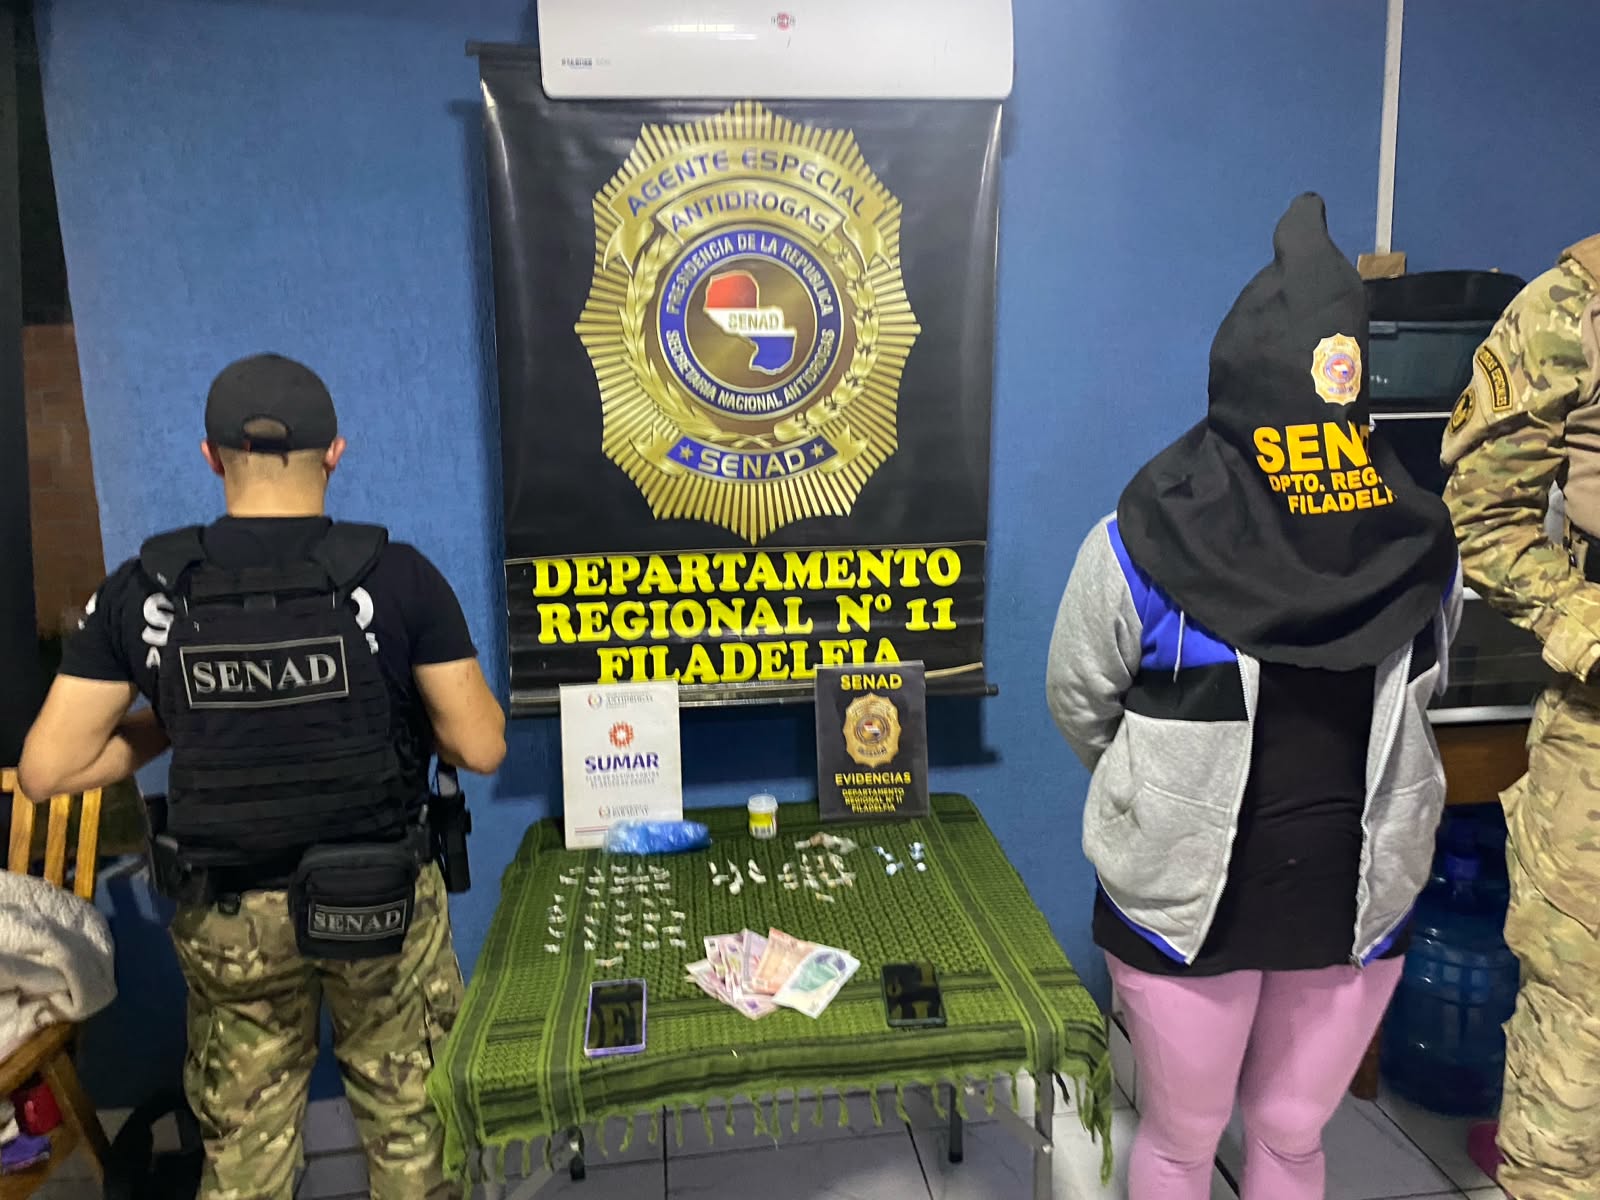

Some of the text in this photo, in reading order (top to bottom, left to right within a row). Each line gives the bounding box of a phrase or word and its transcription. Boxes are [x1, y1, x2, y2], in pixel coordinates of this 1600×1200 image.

[627, 147, 865, 216] AGENTE ESPECIAL
[671, 190, 830, 233] ANTIDROGAS
[666, 237, 734, 316] PRESIDENCIA
[737, 233, 756, 251] DE
[760, 235, 777, 254] LA
[728, 312, 779, 331] SENAD
[666, 329, 836, 412] SECRETARIA NACIONAL ANTIDROGAS
[698, 448, 806, 479] SENAD
[1253, 420, 1371, 474] SEN
[1268, 466, 1383, 493] DPTO. REG.
[532, 547, 962, 598] DEPARTAMENTO
[537, 597, 814, 643] REGIONAL
[905, 598, 957, 631] 11
[192, 653, 337, 693] SENAD
[840, 673, 903, 691] SENAD
[585, 752, 660, 774] SUMAR
[835, 771, 912, 787] EVIDENCIAS
[842, 787, 905, 798] DEPARTAMENTO
[313, 909, 401, 932] SENAD
